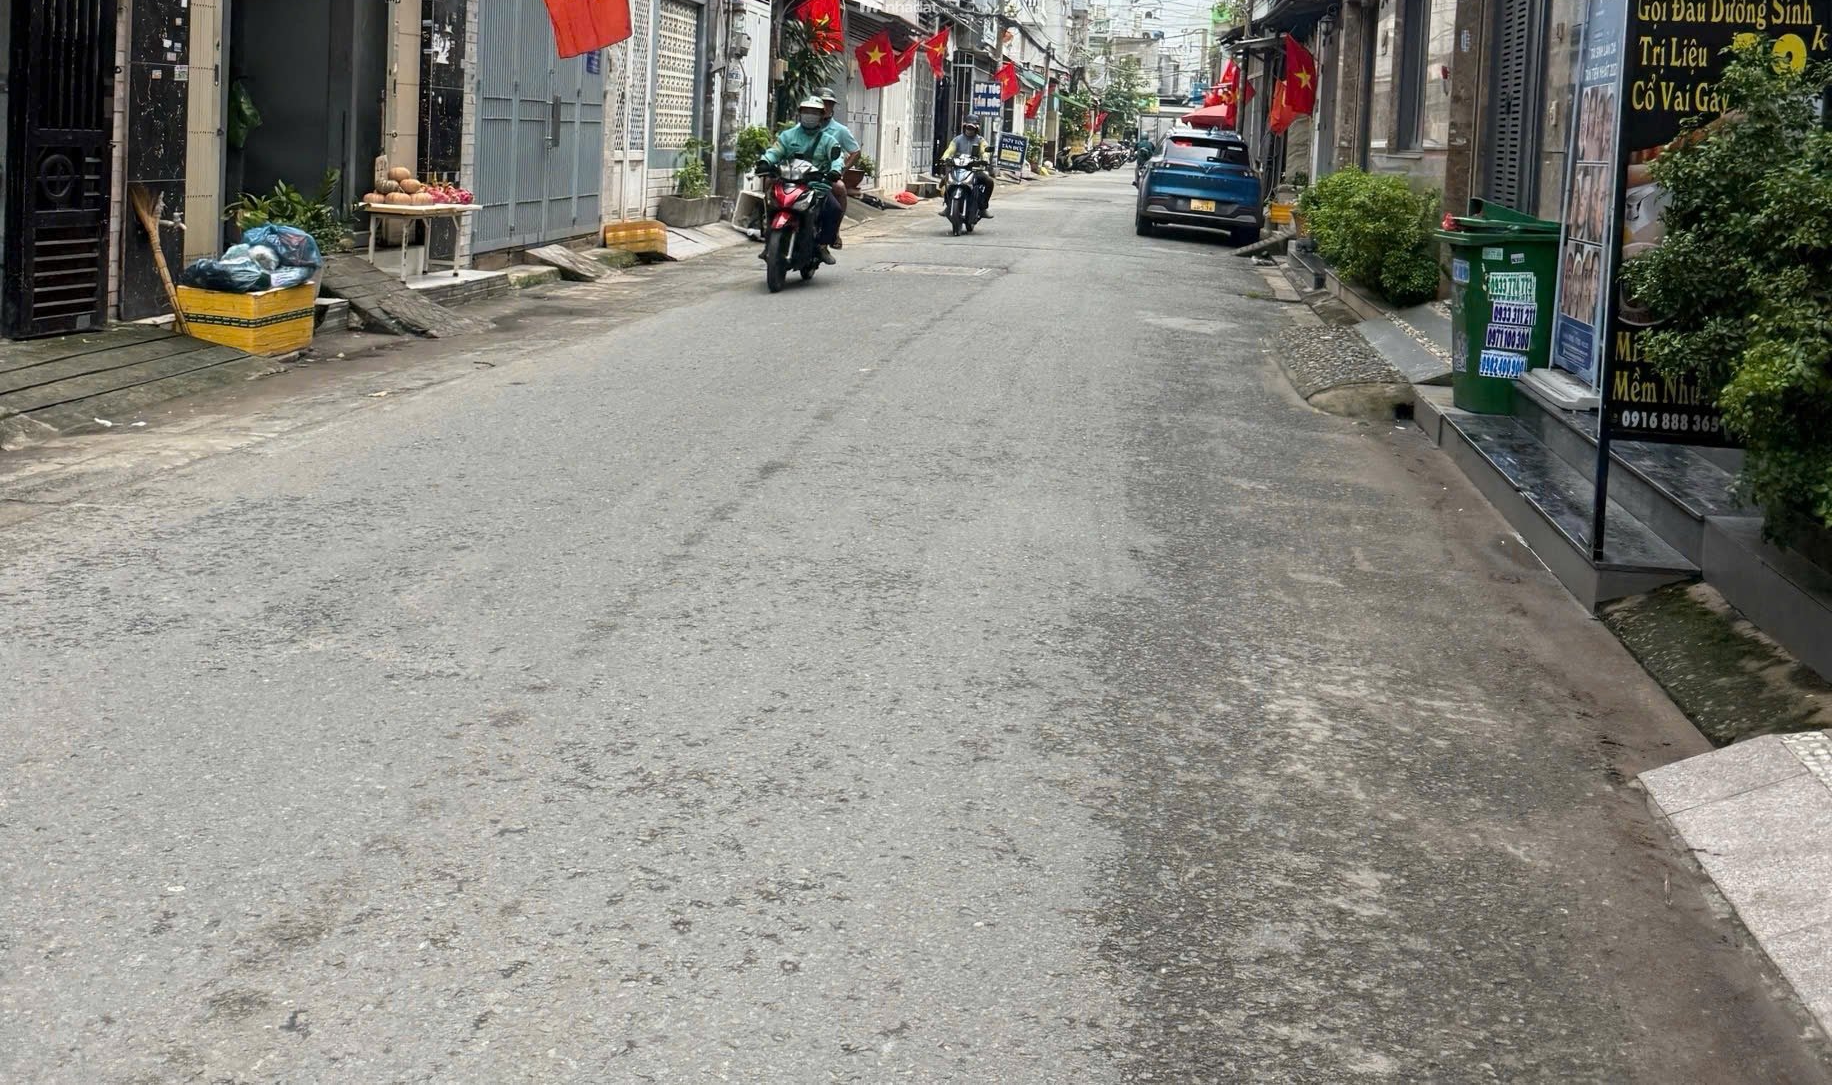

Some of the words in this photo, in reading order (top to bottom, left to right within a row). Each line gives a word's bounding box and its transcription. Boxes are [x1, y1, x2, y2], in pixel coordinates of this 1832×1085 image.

[1639, 36, 1666, 75] Trị
[1669, 36, 1708, 76] Liệu
[1631, 73, 1656, 111] Cổ
[1660, 81, 1690, 112] Vai
[1612, 367, 1658, 404] Mềm
[1621, 410, 1658, 429] 0916
[1661, 413, 1688, 431] 888
[1692, 414, 1720, 433] 365
